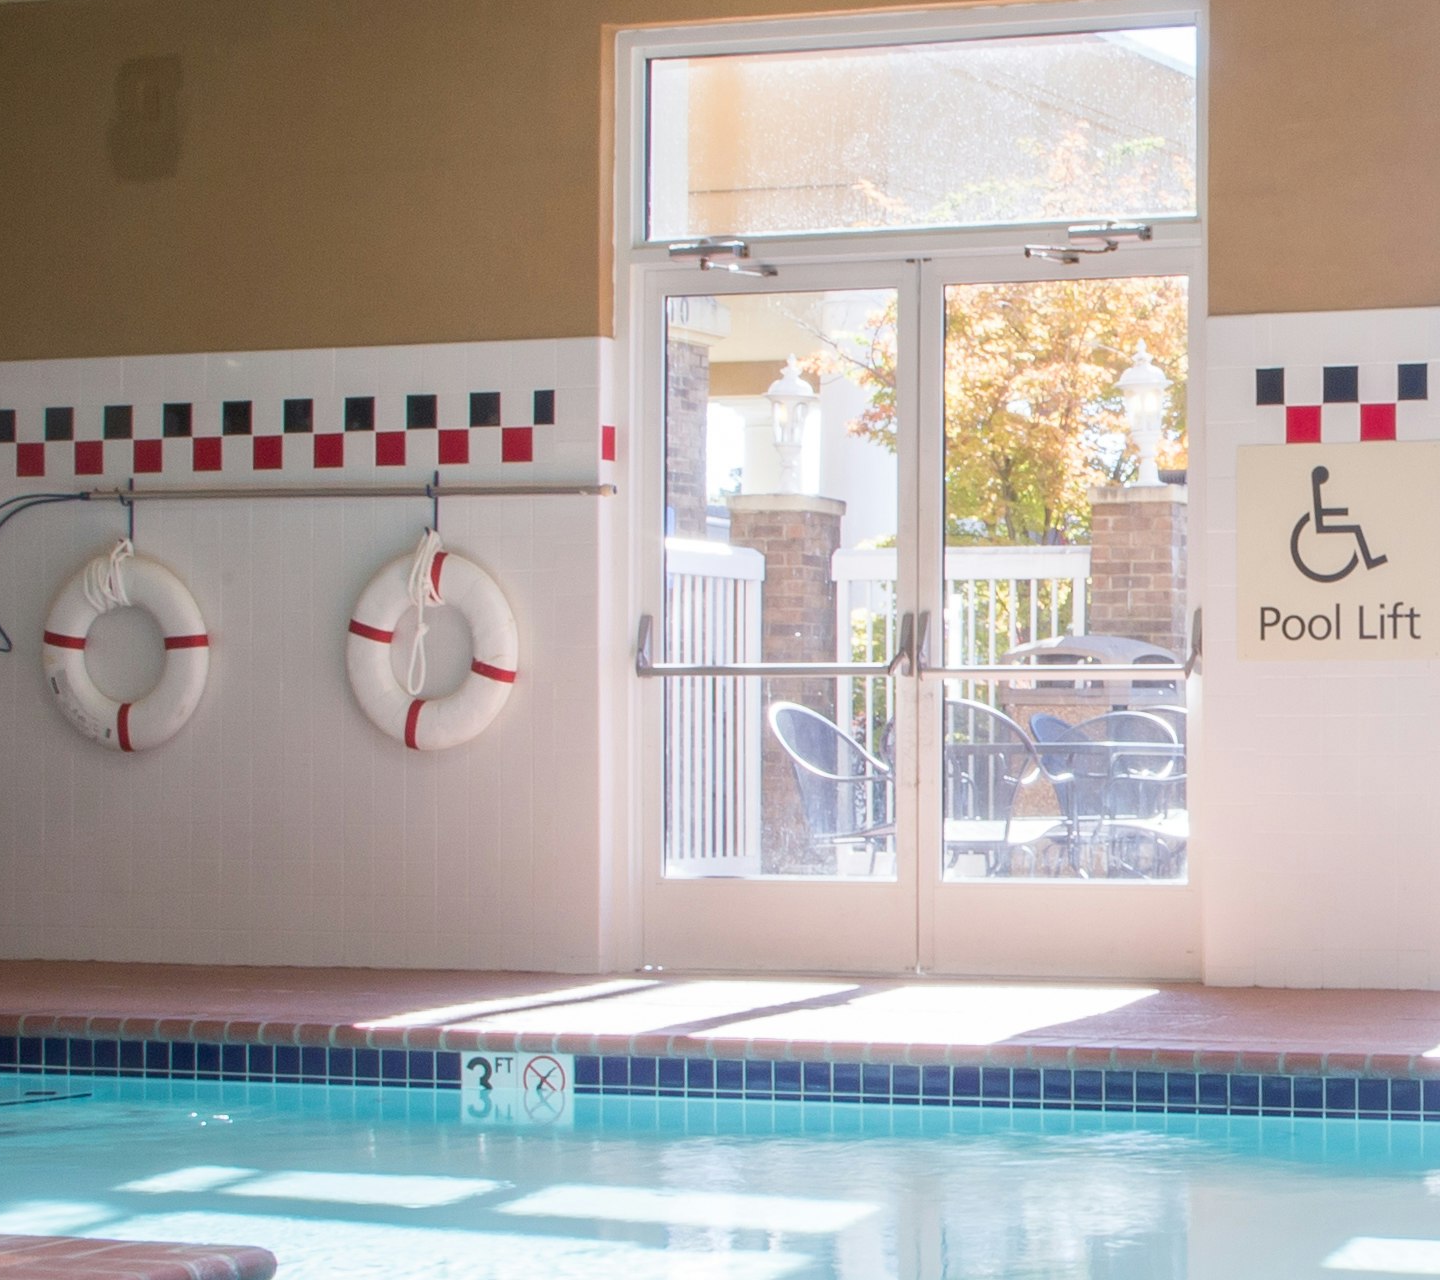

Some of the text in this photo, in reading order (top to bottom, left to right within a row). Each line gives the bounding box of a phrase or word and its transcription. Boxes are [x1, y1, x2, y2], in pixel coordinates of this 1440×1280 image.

[1259, 601, 1421, 641] Pool Lift
[466, 1056, 514, 1090] 3 FT
